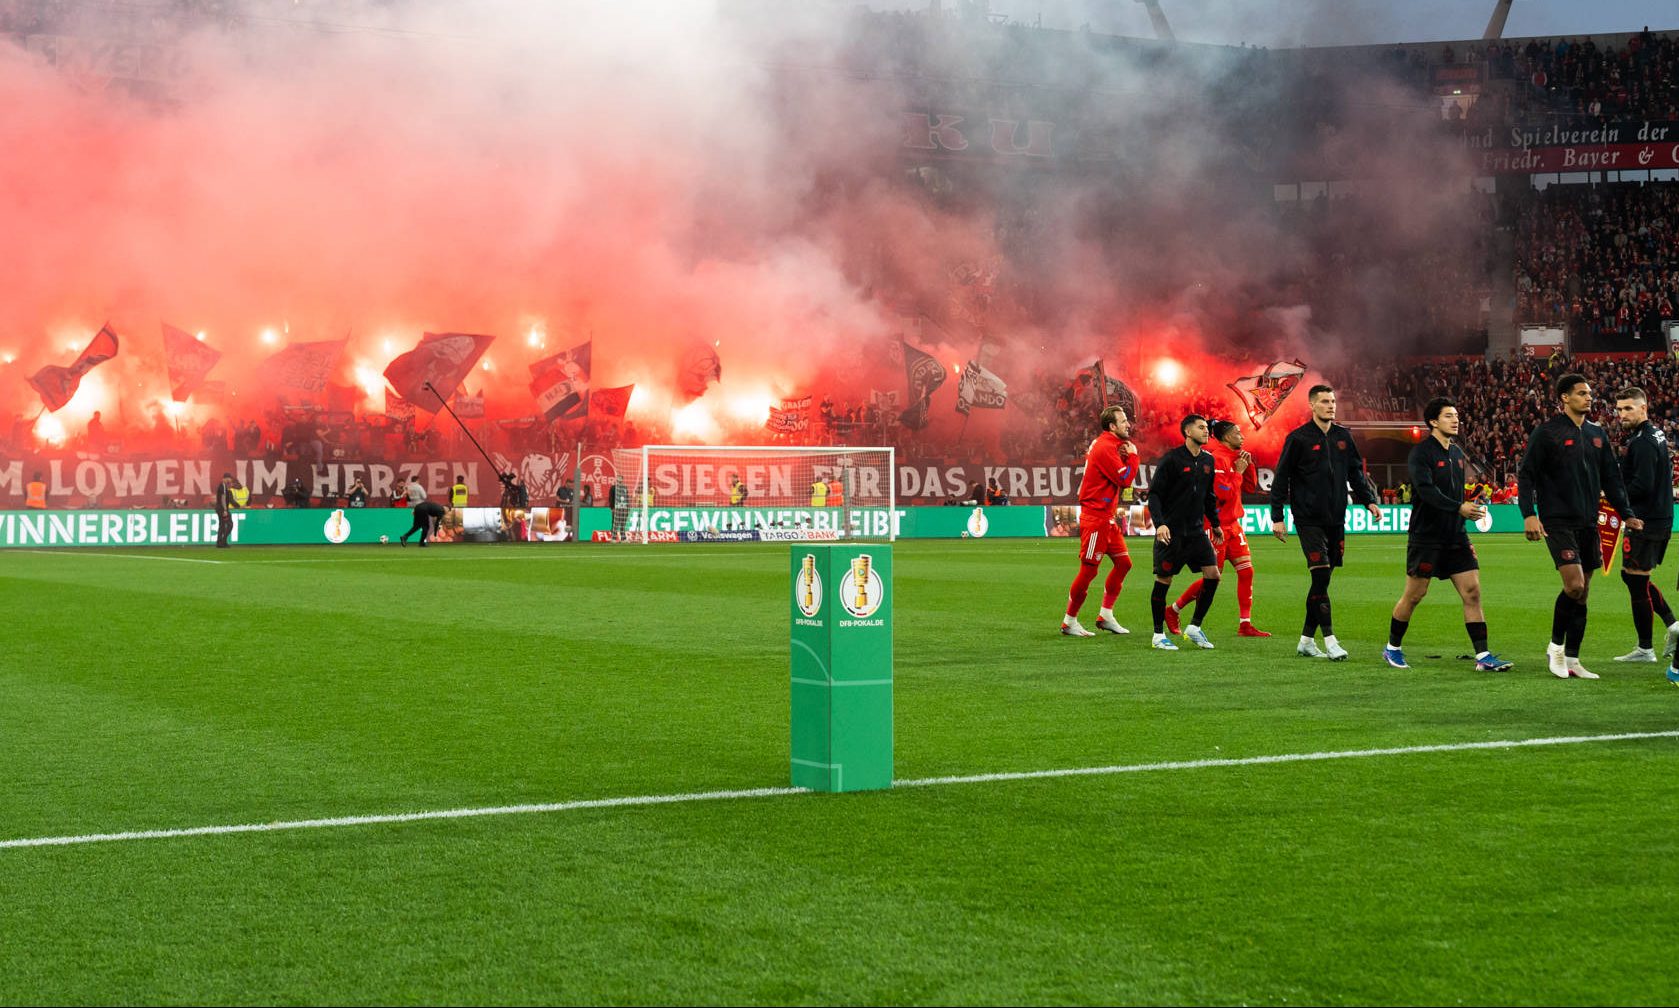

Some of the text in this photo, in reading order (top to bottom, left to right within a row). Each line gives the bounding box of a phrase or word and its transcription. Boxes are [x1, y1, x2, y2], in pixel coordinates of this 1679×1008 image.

[1512, 125, 1619, 150] Spielverein
[1638, 122, 1669, 140] der
[1564, 147, 1620, 168] Bayer
[1638, 146, 1655, 165] &
[49, 451, 213, 497] LÖWEN
[236, 459, 288, 496] IM
[655, 463, 793, 498] SIEGEN
[900, 465, 968, 497] DAS
[0, 513, 246, 544] INNERBLEIBT
[807, 531, 837, 540] BANK
[839, 619, 884, 627] DFB-POKAL.DE
